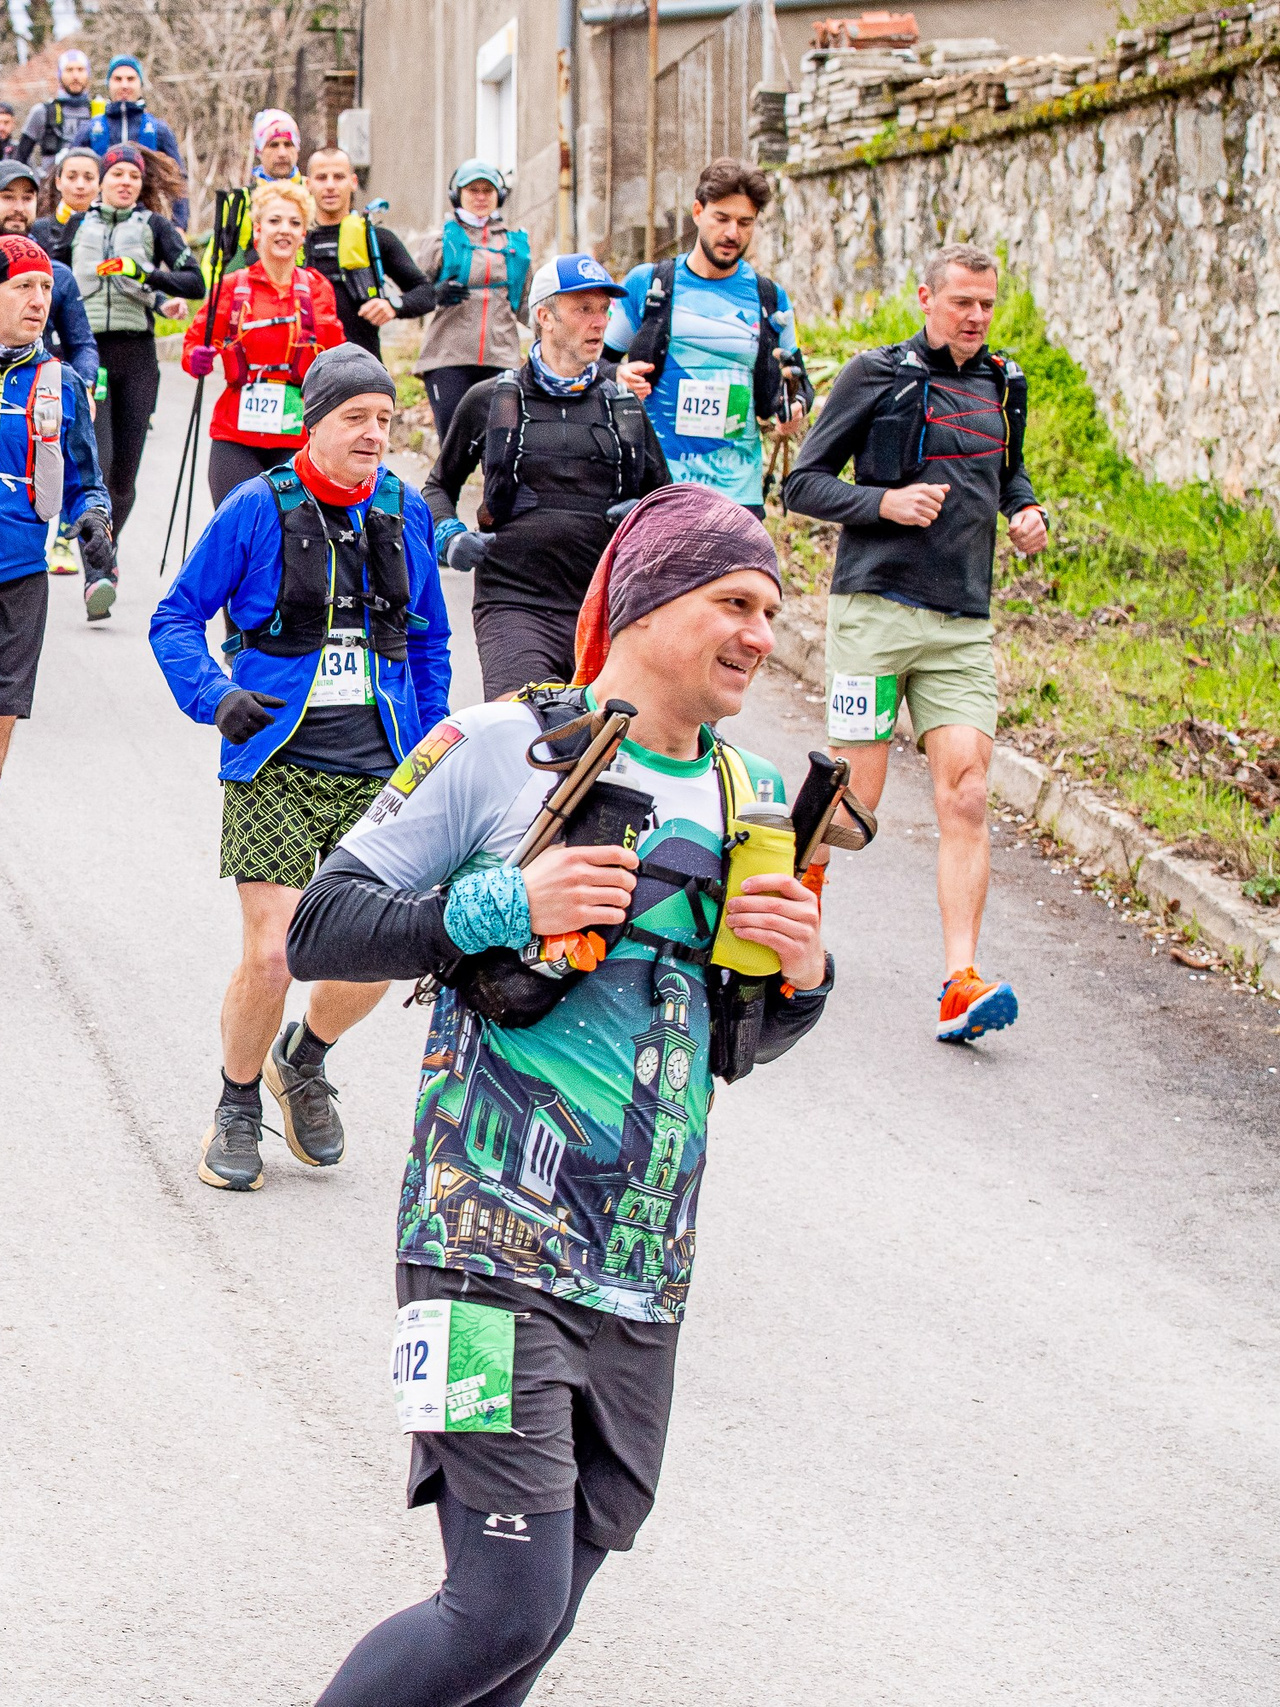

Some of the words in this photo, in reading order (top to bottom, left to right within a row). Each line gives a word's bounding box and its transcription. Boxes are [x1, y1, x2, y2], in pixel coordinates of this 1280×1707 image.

[245, 397, 278, 413] 4127
[683, 397, 721, 416] 4125
[321, 652, 357, 676] 134
[832, 694, 867, 715] 4129
